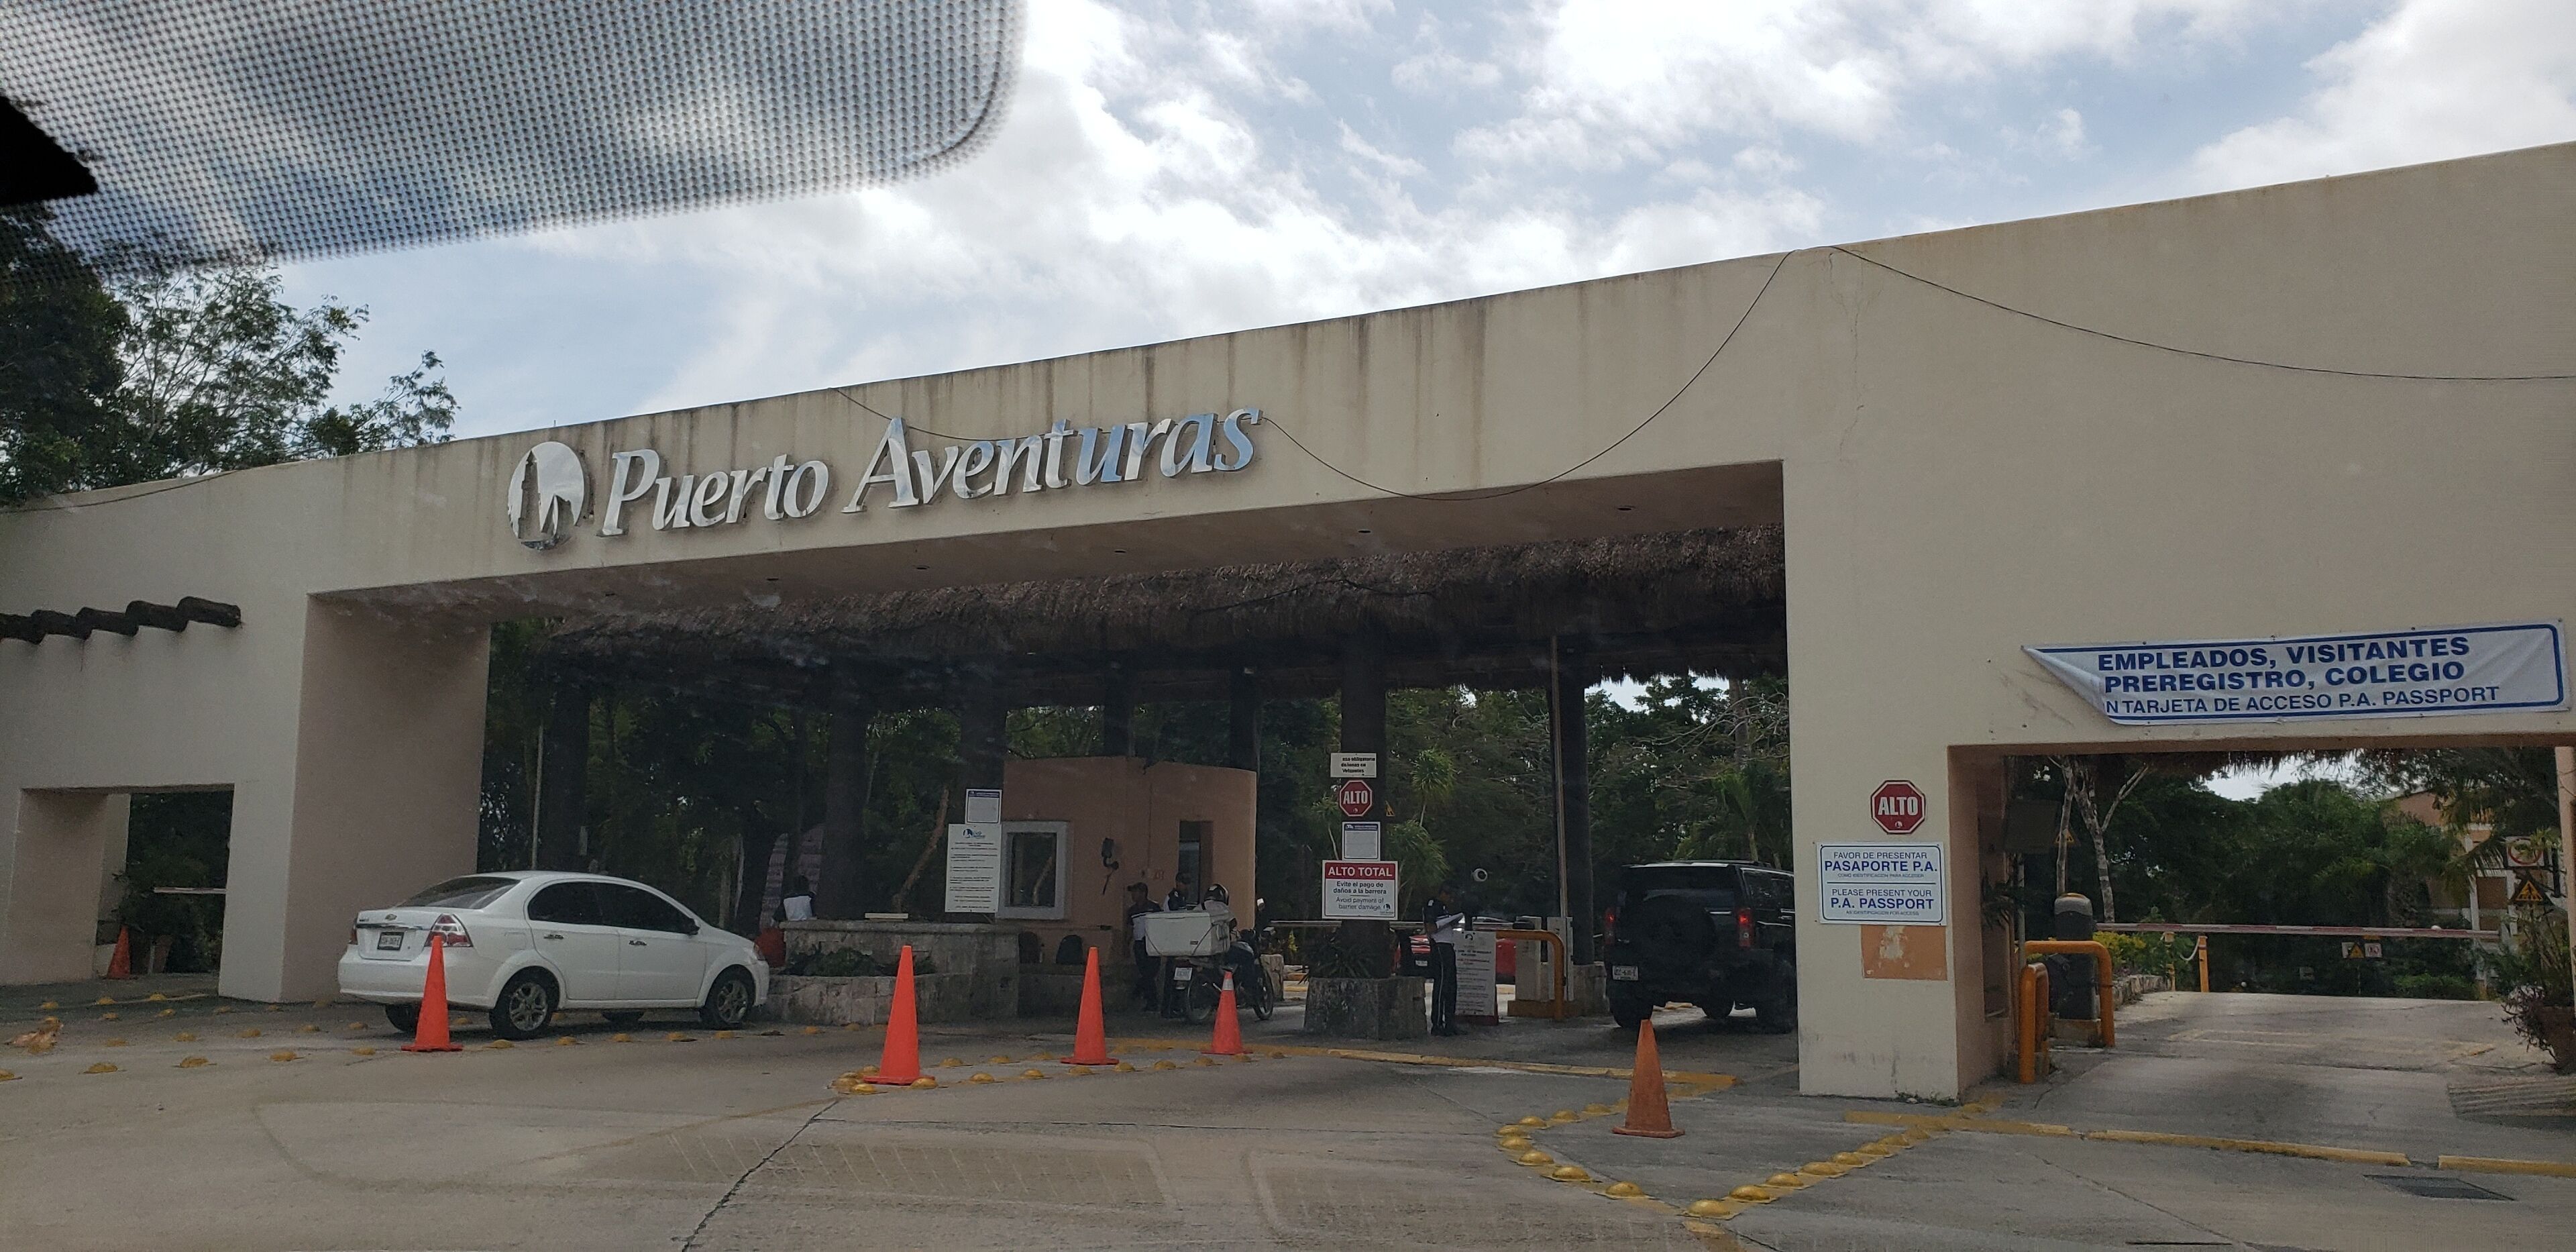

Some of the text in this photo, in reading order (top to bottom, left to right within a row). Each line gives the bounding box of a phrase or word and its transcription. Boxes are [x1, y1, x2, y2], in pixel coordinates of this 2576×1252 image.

[597, 407, 1261, 537] Puerto Aventuras
[2098, 637, 2469, 671] EMPLEADOS, VISITANTES
[2105, 662, 2464, 693] PREREGISTRO, COLEGIO
[2122, 698, 2207, 713] TARJETA
[2214, 697, 2240, 712] DE
[2245, 693, 2332, 710] ACCESO
[2339, 692, 2376, 707] P.A.
[2383, 686, 2500, 706] PASSPORT
[1343, 791, 1368, 804] ALTO
[1878, 796, 1919, 815] ALTO
[1328, 866, 1393, 877] ALTO TOTAL
[1825, 861, 1938, 872] PASAPORTE P.A.
[1866, 889, 1905, 897] PRESENT
[1831, 898, 1934, 910] P.A. PASSPORT
